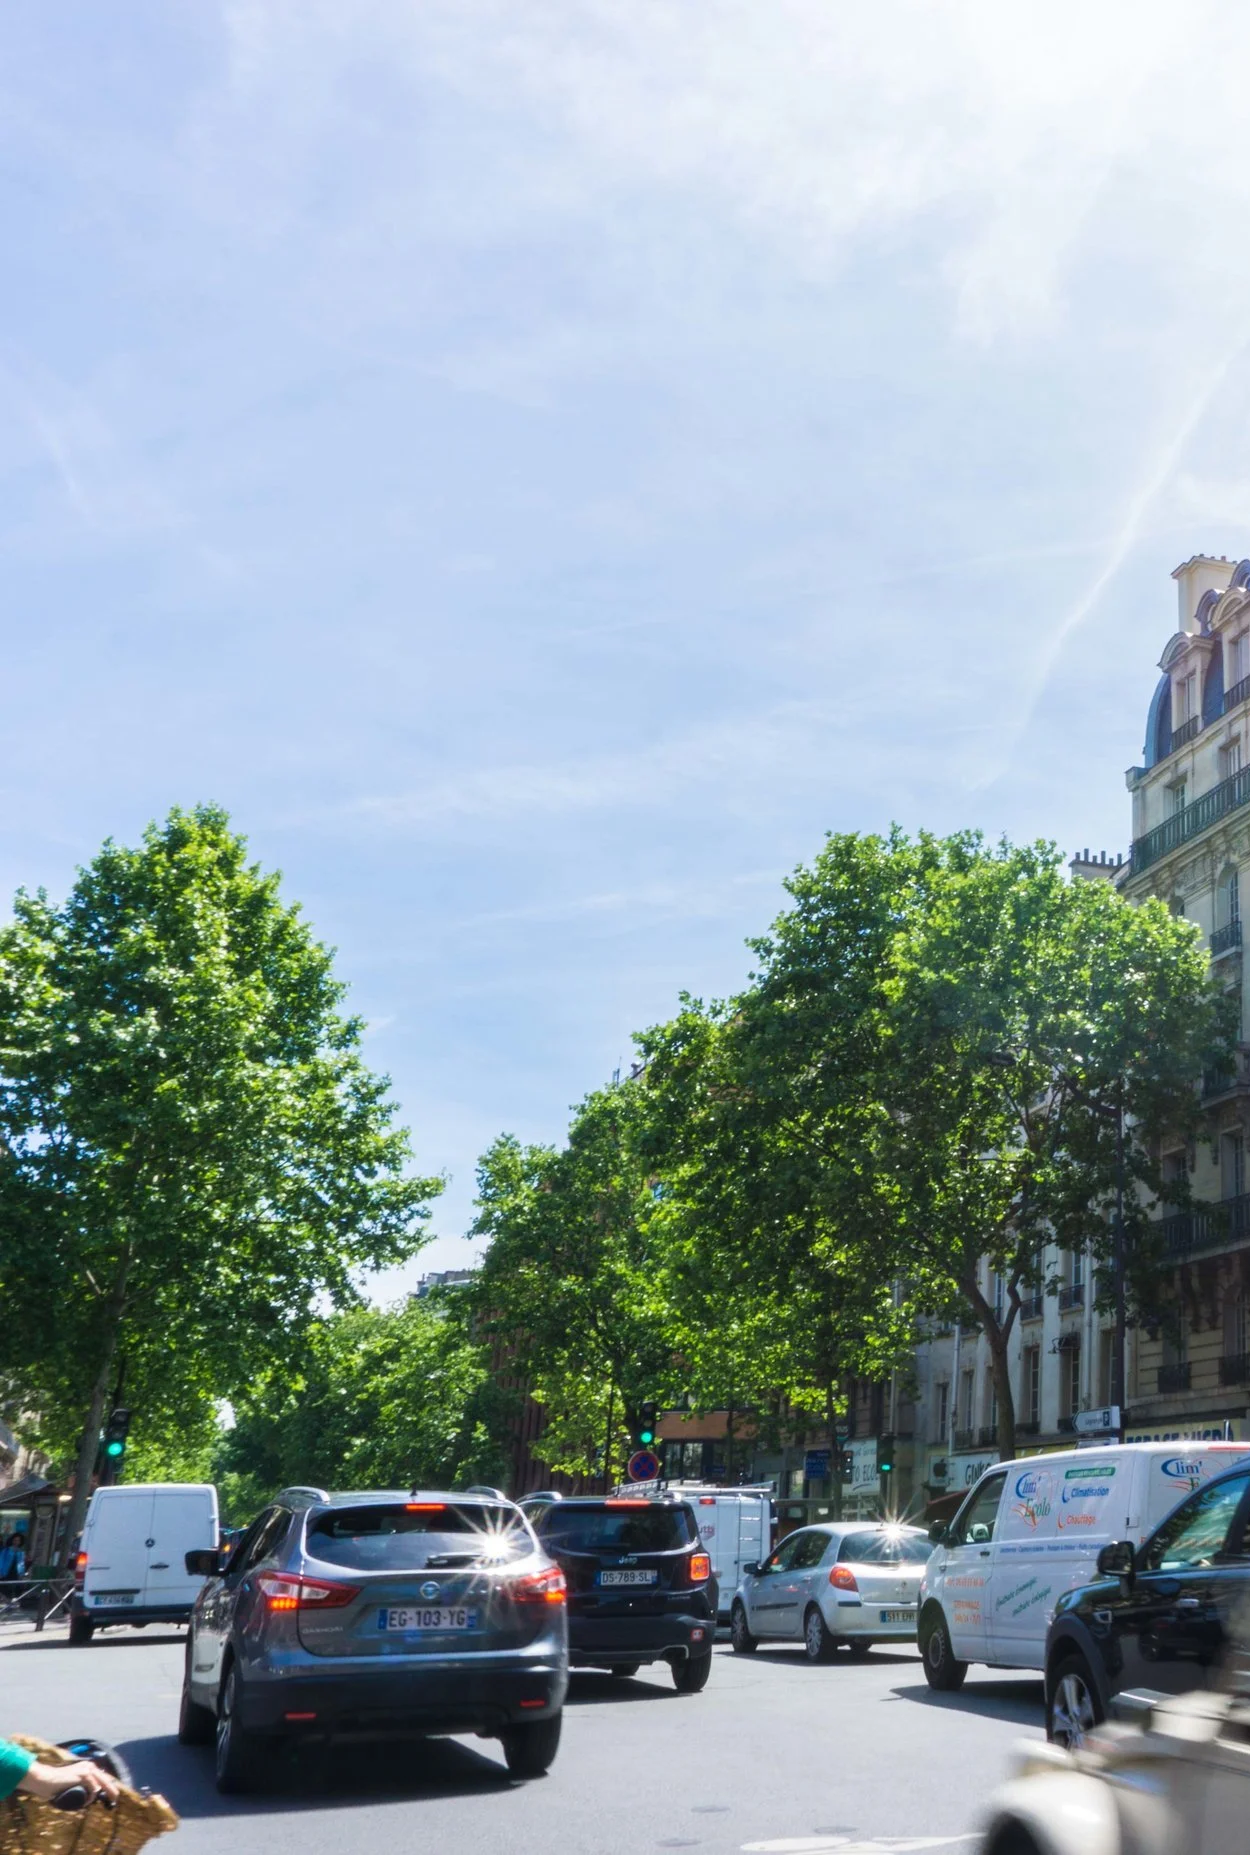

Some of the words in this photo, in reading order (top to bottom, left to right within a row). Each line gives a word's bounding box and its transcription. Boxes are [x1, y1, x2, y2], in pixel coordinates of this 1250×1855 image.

[619, 1557, 638, 1565] Jeep
[602, 1572, 652, 1584] DS-789-SL
[388, 1610, 466, 1628] EG-103-YG
